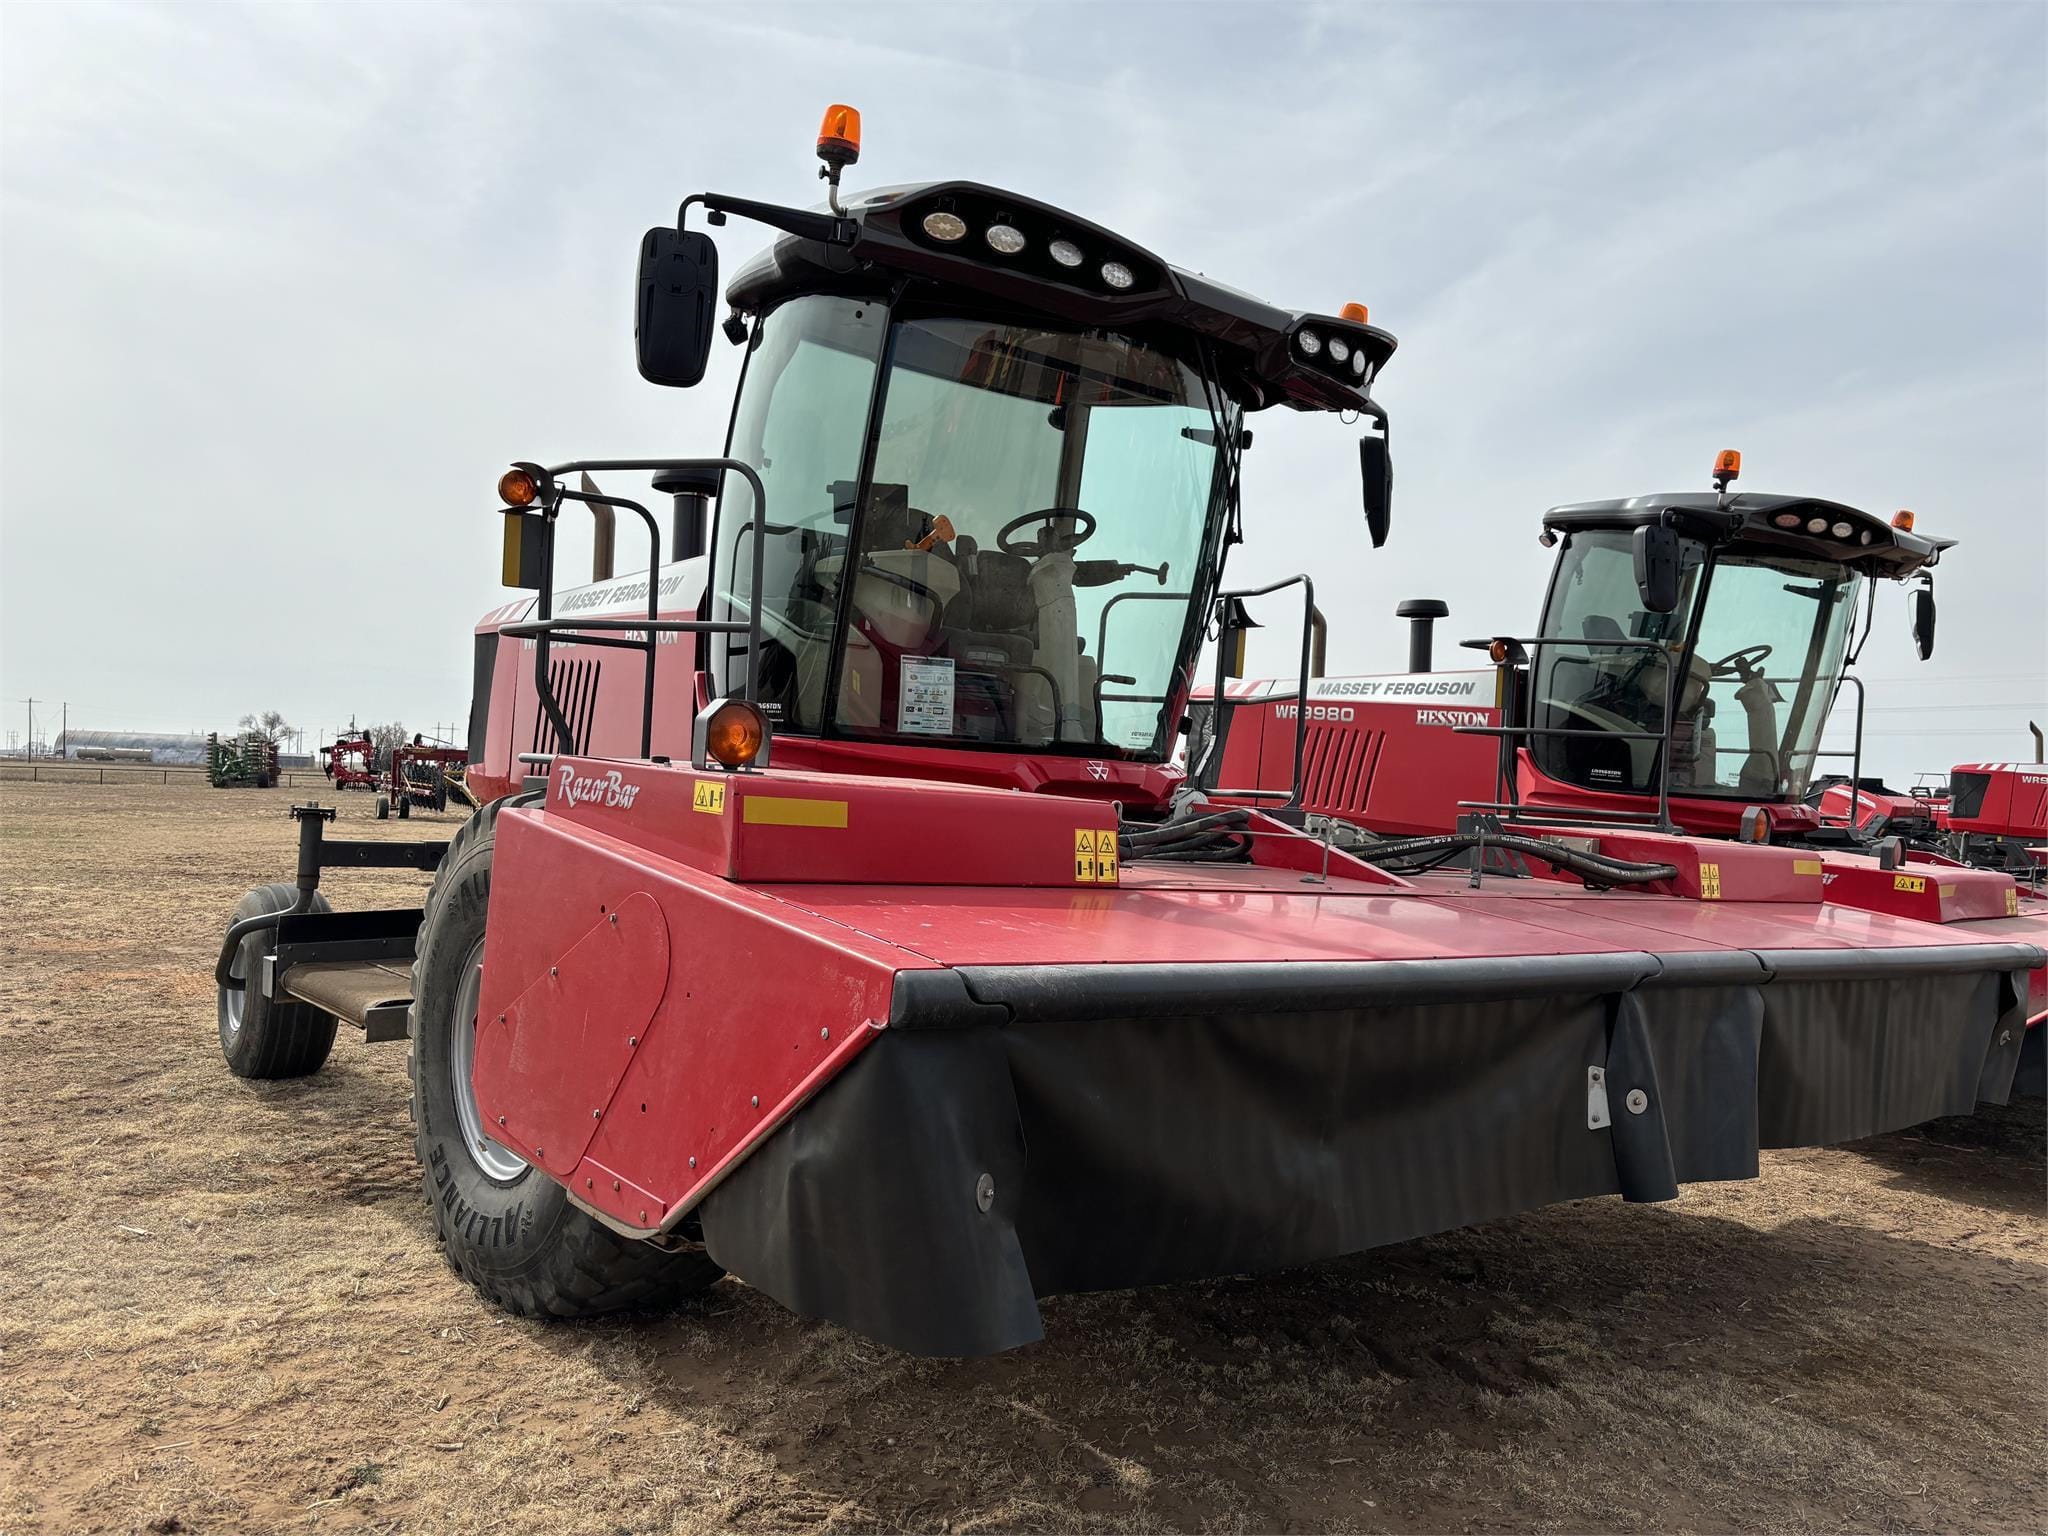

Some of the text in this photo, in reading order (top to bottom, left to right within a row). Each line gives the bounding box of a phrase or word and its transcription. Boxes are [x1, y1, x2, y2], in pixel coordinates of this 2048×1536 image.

[559, 588, 612, 613] MASSEY
[1316, 681, 1476, 696] MASSEY FERGUSON
[1275, 704, 1354, 722] WR9980
[1416, 709, 1490, 728] HESSTON
[429, 1143, 525, 1249] ALLIANCE
